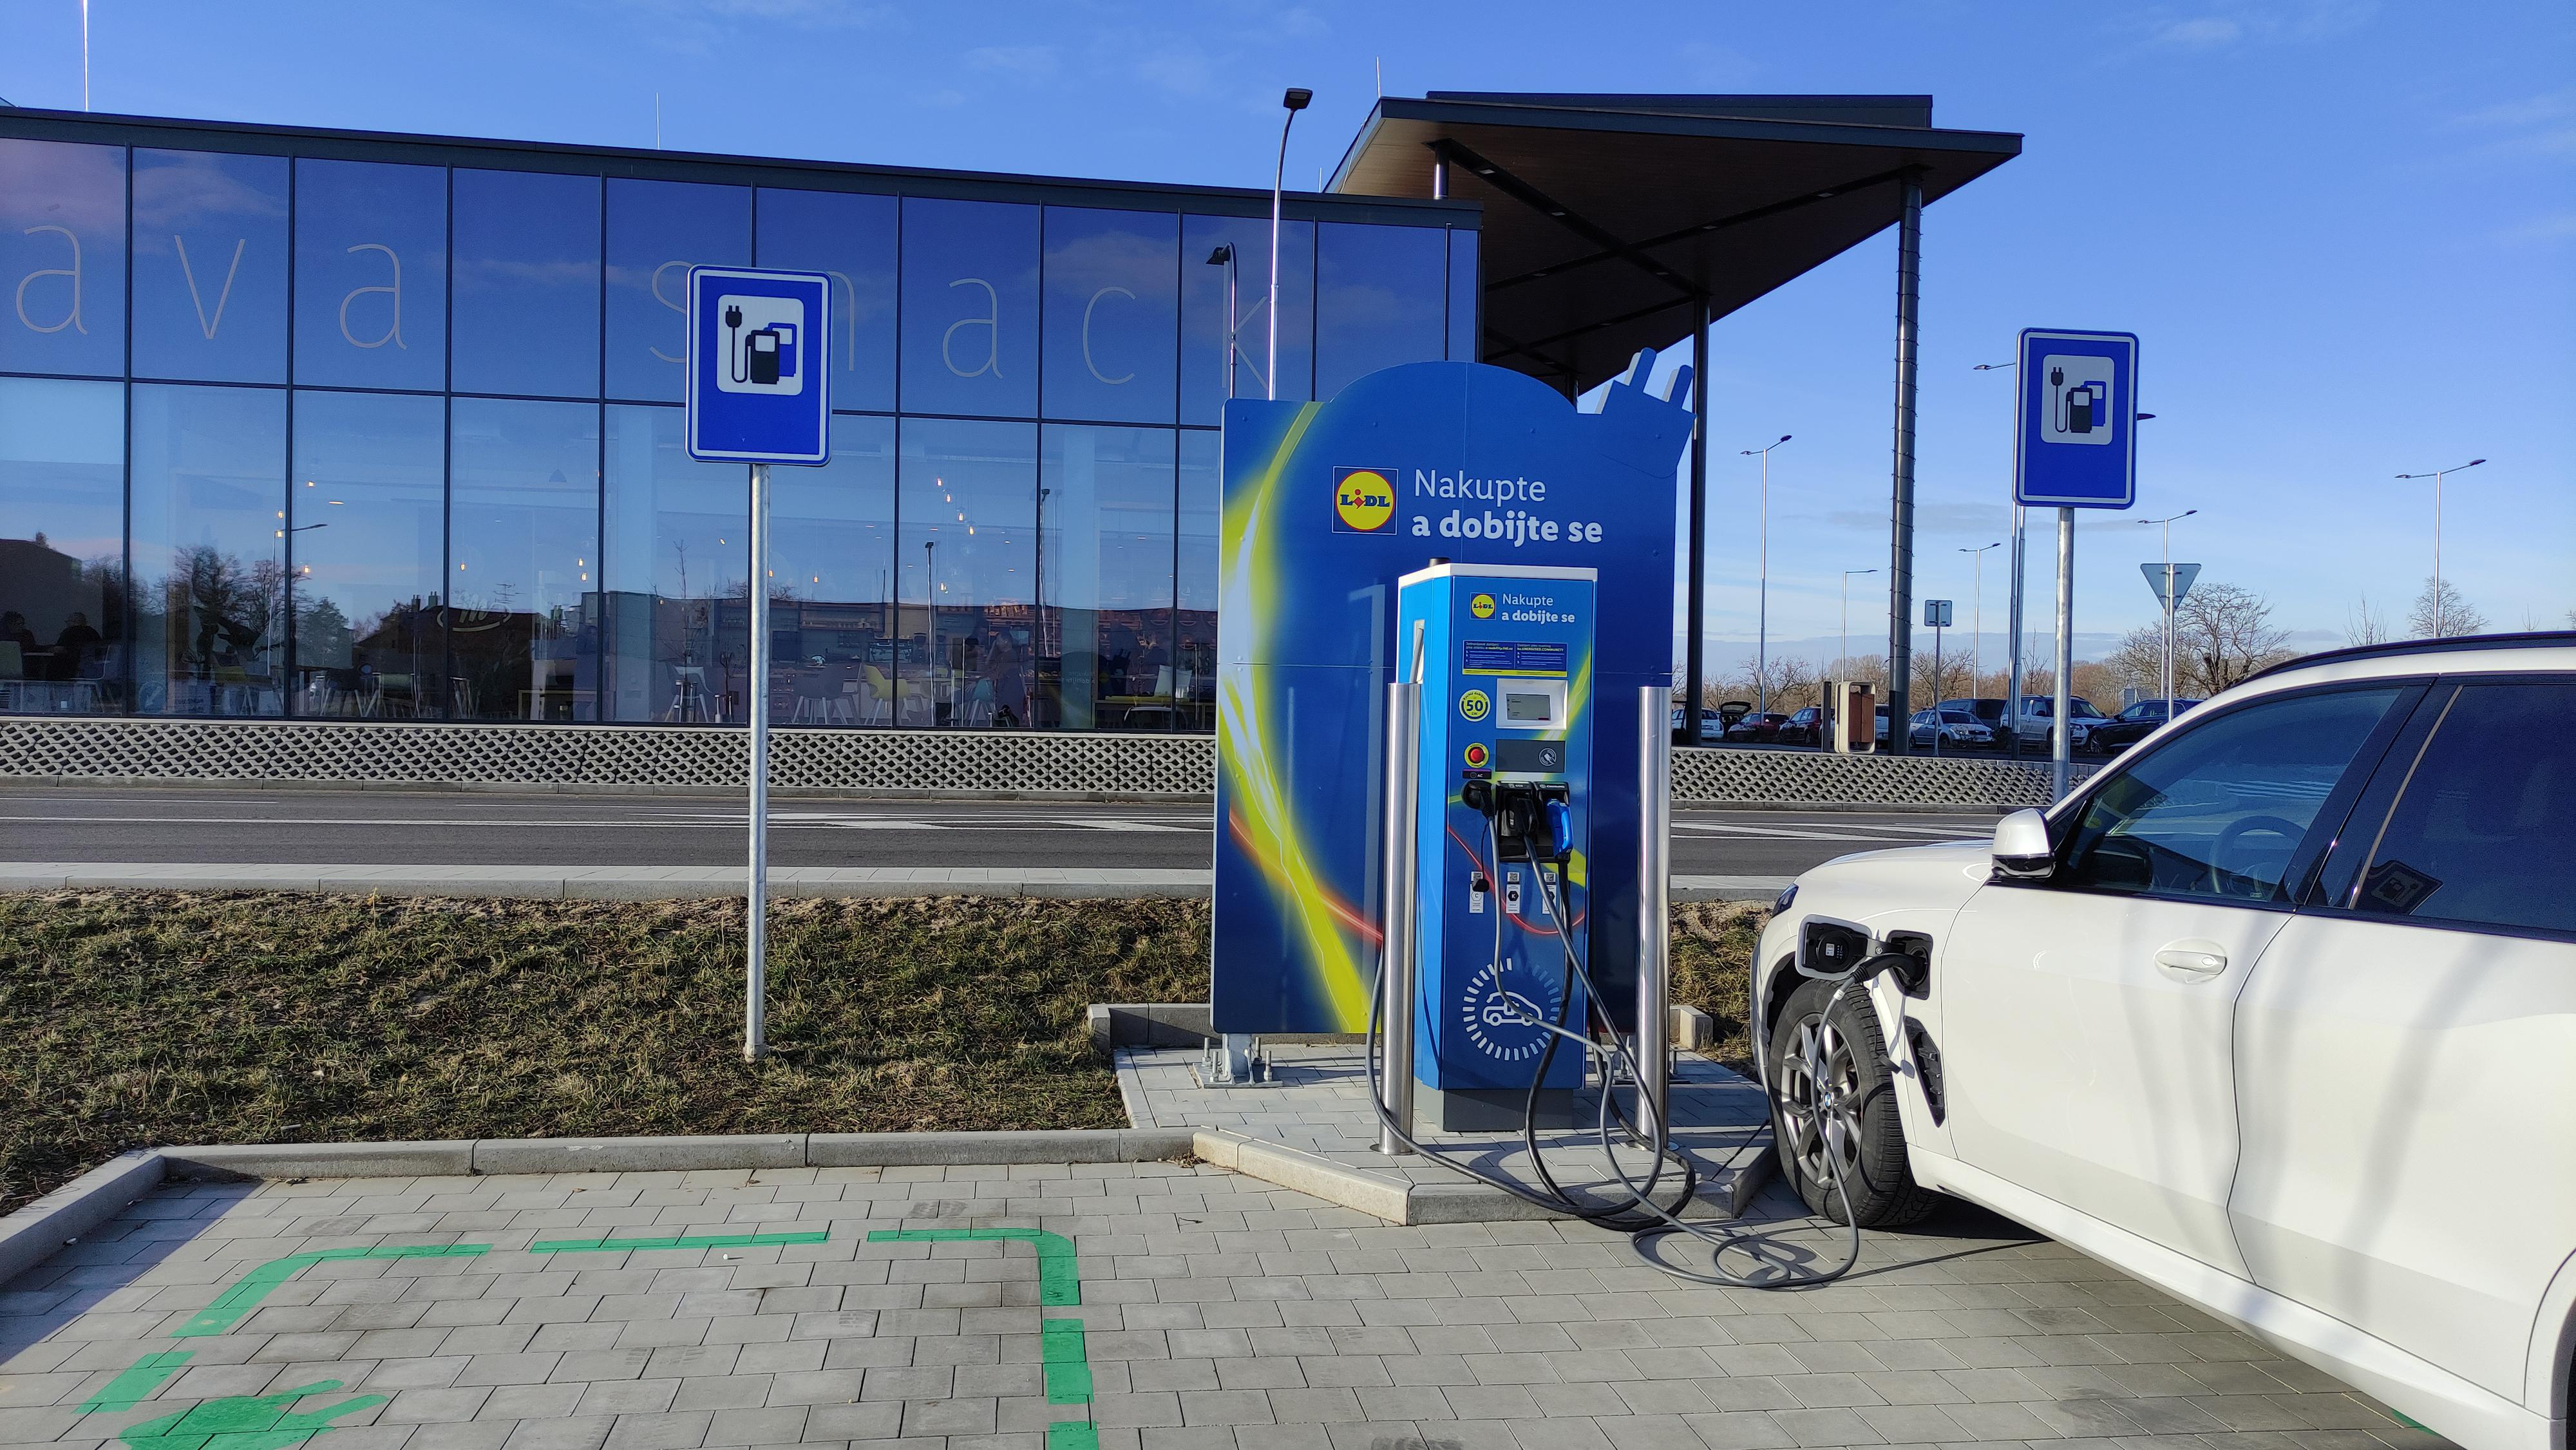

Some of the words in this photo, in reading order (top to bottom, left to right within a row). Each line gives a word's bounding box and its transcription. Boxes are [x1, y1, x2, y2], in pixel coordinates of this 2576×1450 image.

[1414, 469, 1546, 507] Nakupte
[1412, 515, 1431, 536] a
[1439, 509, 1559, 547] dobijte
[1567, 521, 1603, 543] se
[1502, 593, 1553, 608] Nakupte
[1501, 612, 1510, 621] a
[1512, 610, 1558, 625] dobijte
[1561, 614, 1575, 623] se
[1466, 699, 1483, 711] 50
